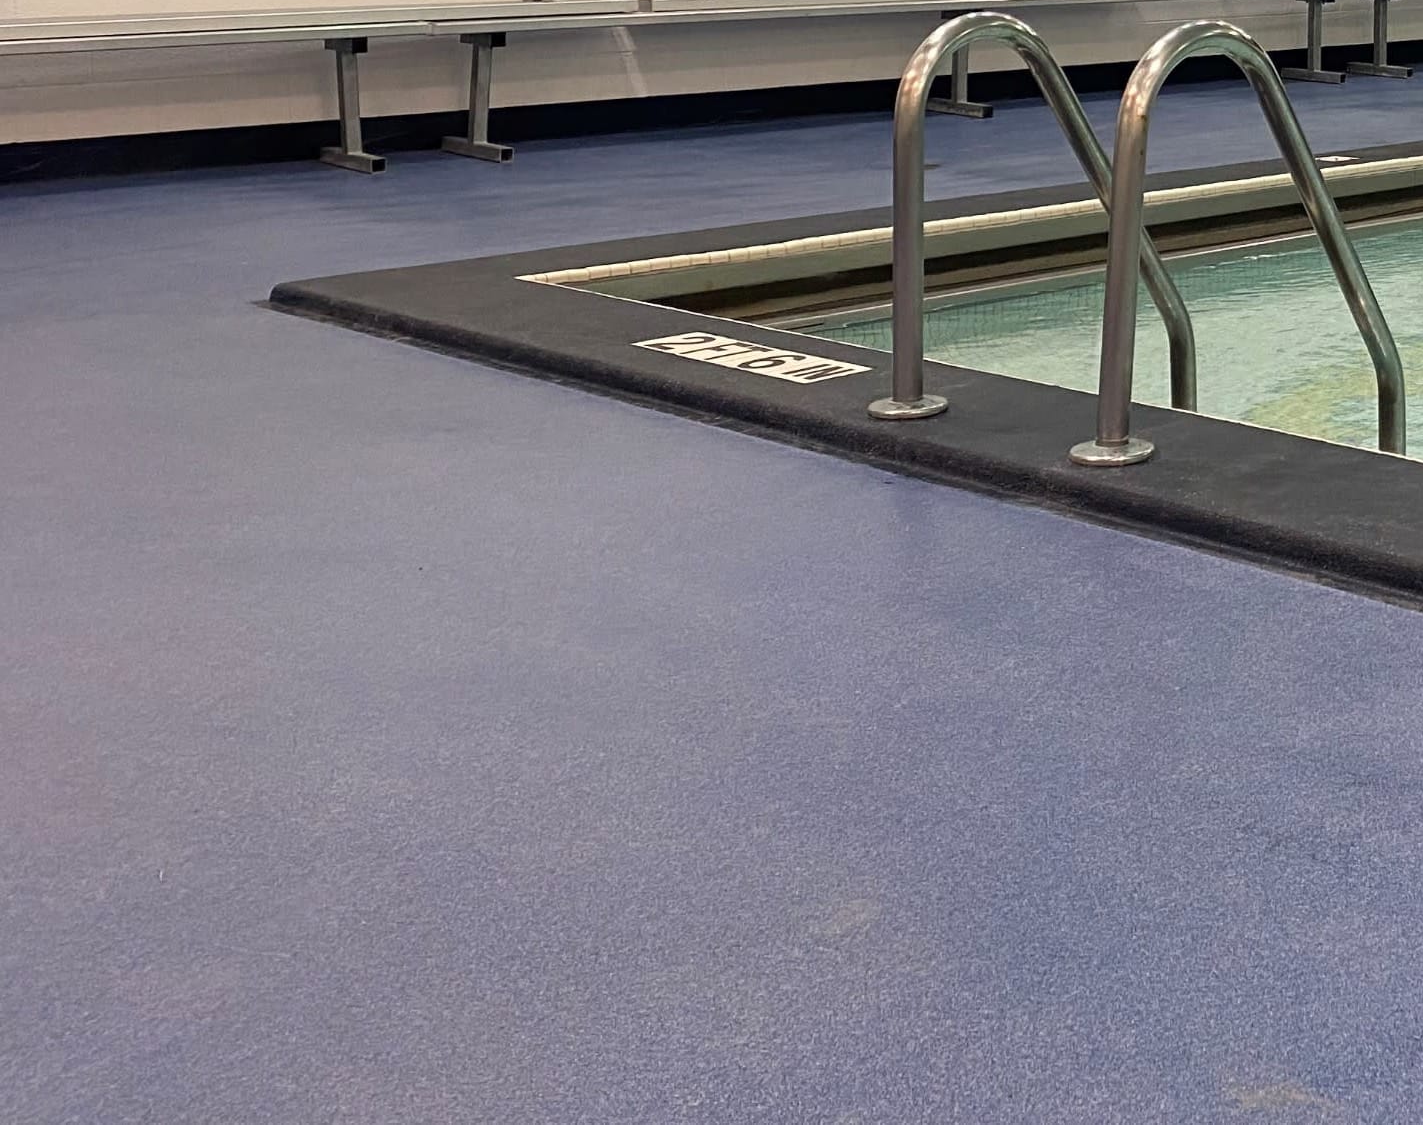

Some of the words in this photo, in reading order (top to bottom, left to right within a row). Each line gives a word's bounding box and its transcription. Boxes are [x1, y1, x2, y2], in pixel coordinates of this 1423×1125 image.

[643, 336, 717, 351] 2
[679, 342, 774, 361] FT
[736, 354, 807, 369] 6
[781, 363, 855, 381] IN
